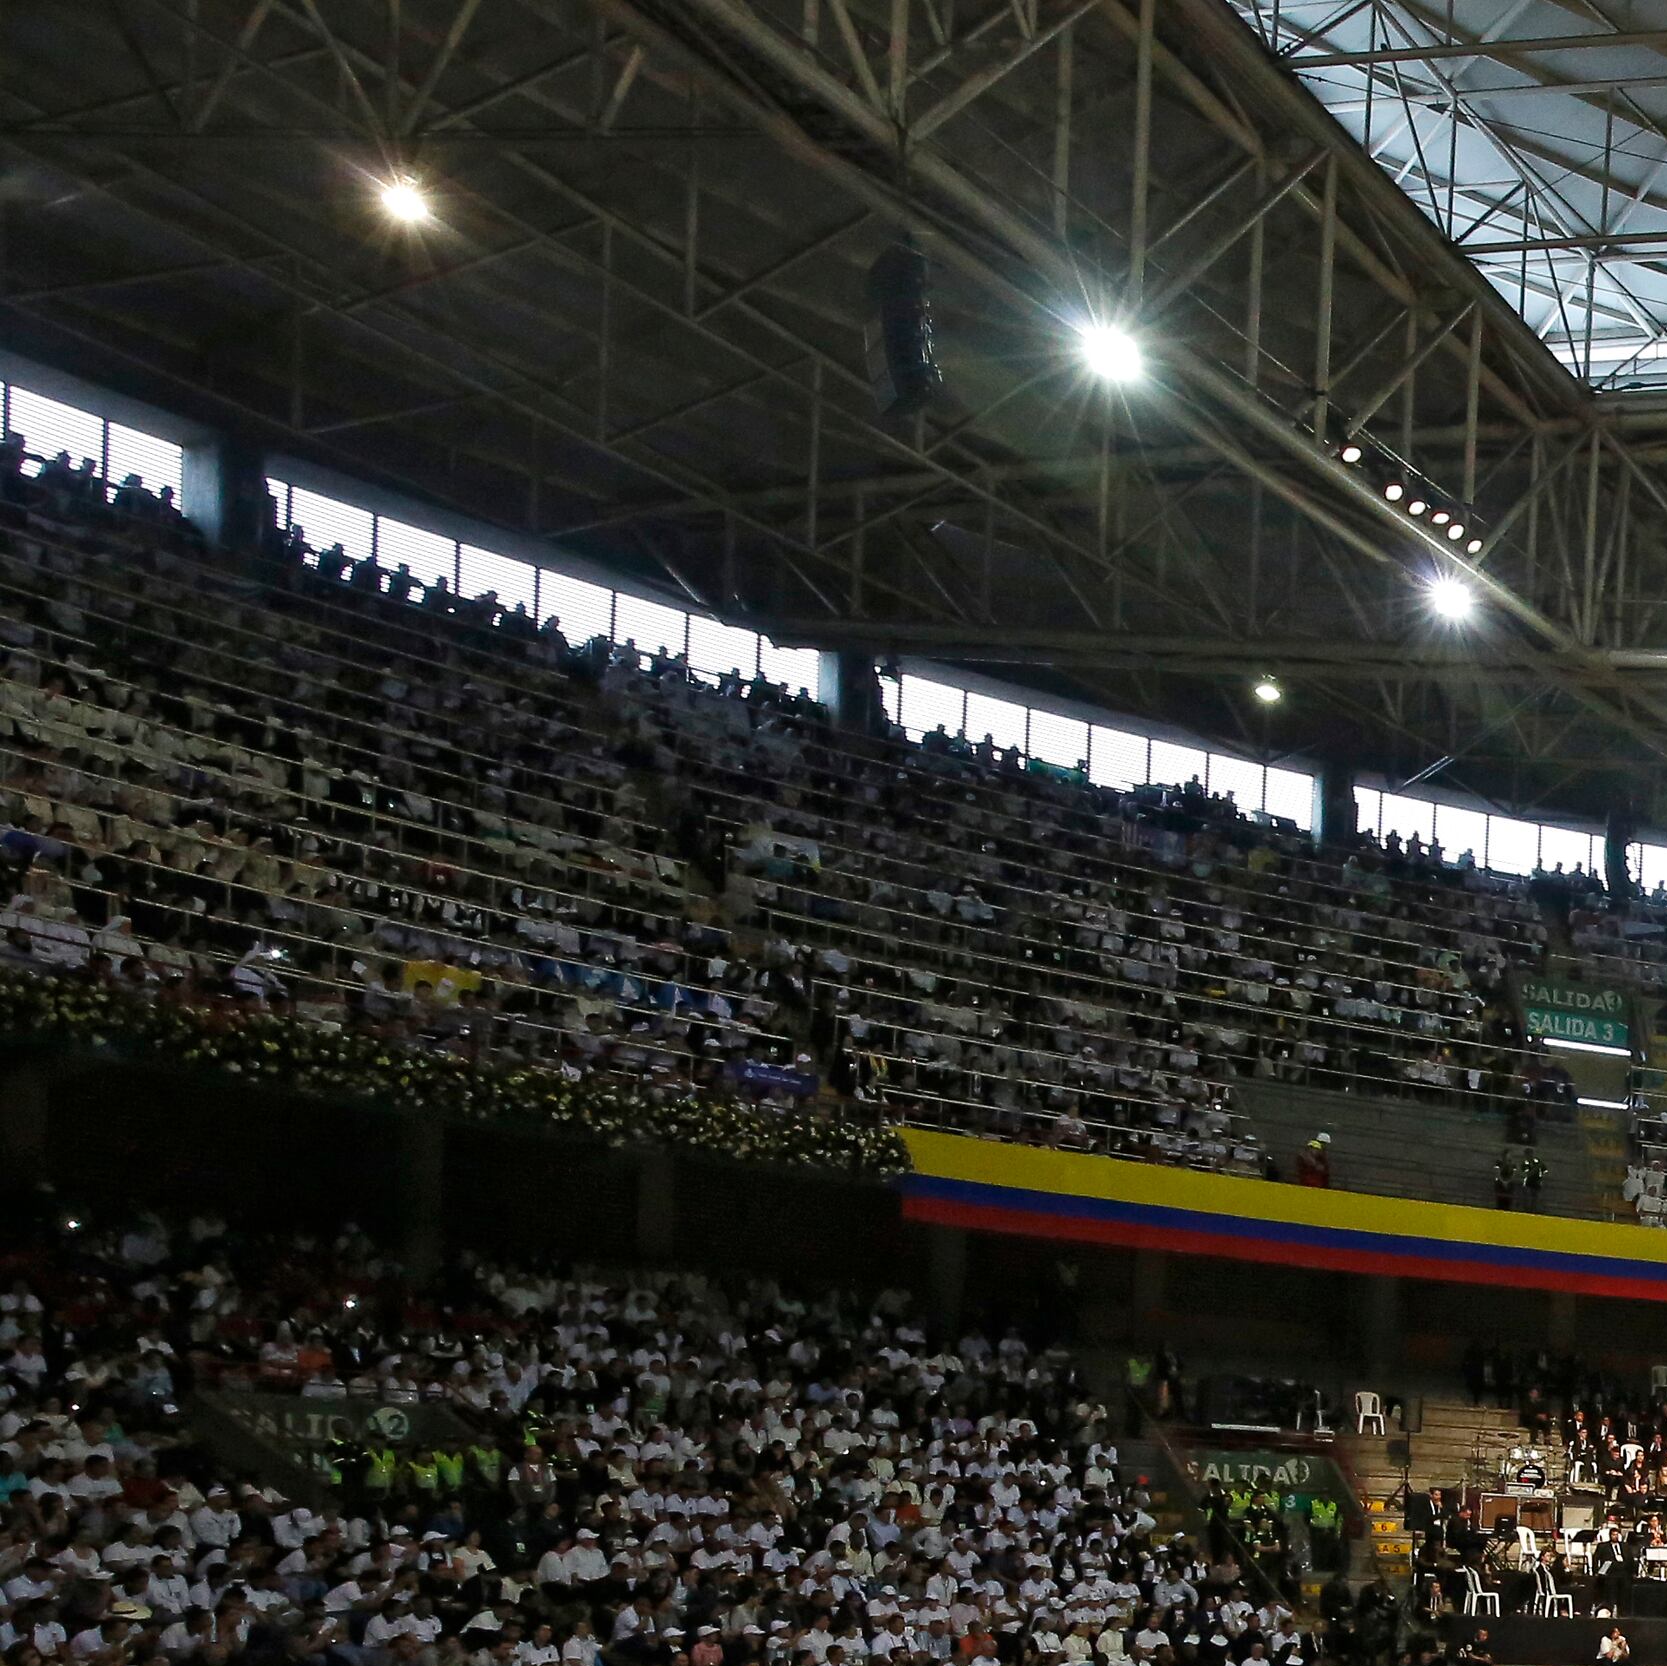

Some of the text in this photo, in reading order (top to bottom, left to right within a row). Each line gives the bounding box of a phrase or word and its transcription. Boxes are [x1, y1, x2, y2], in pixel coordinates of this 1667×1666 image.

[1527, 1012, 1614, 1041] SALIDA 3
[389, 1414, 405, 1436] 2
[1284, 1494, 1297, 1508] 3
